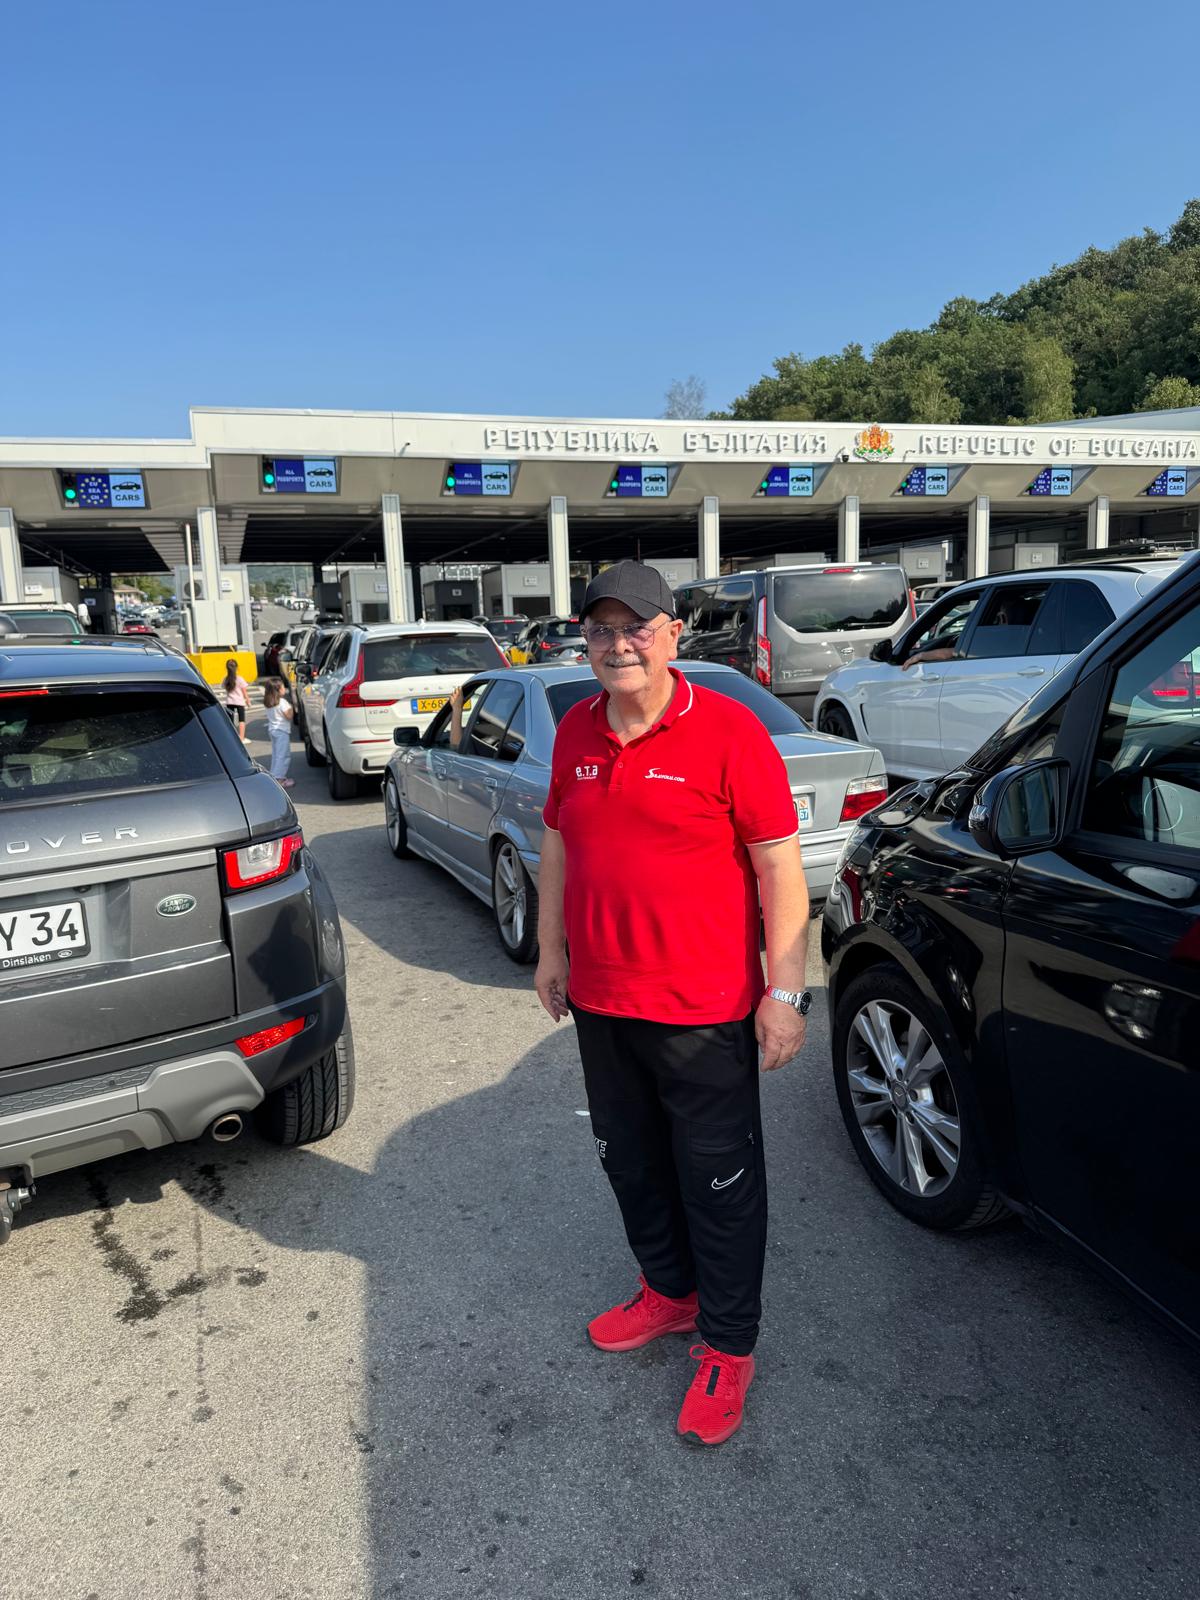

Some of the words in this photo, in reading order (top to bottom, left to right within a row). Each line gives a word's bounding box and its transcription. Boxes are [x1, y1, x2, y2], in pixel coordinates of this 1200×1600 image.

[485, 427, 661, 452] РЕПУБЛИКА
[684, 431, 828, 453] БЪЛГАРИЯ
[919, 434, 1038, 456] REPUBLIC
[1049, 438, 1078, 456] OF
[1088, 438, 1198, 458] BULGARIA
[0, 916, 17, 951] Y
[30, 908, 79, 946] 34
[2, 953, 52, 968] Dinslaken
